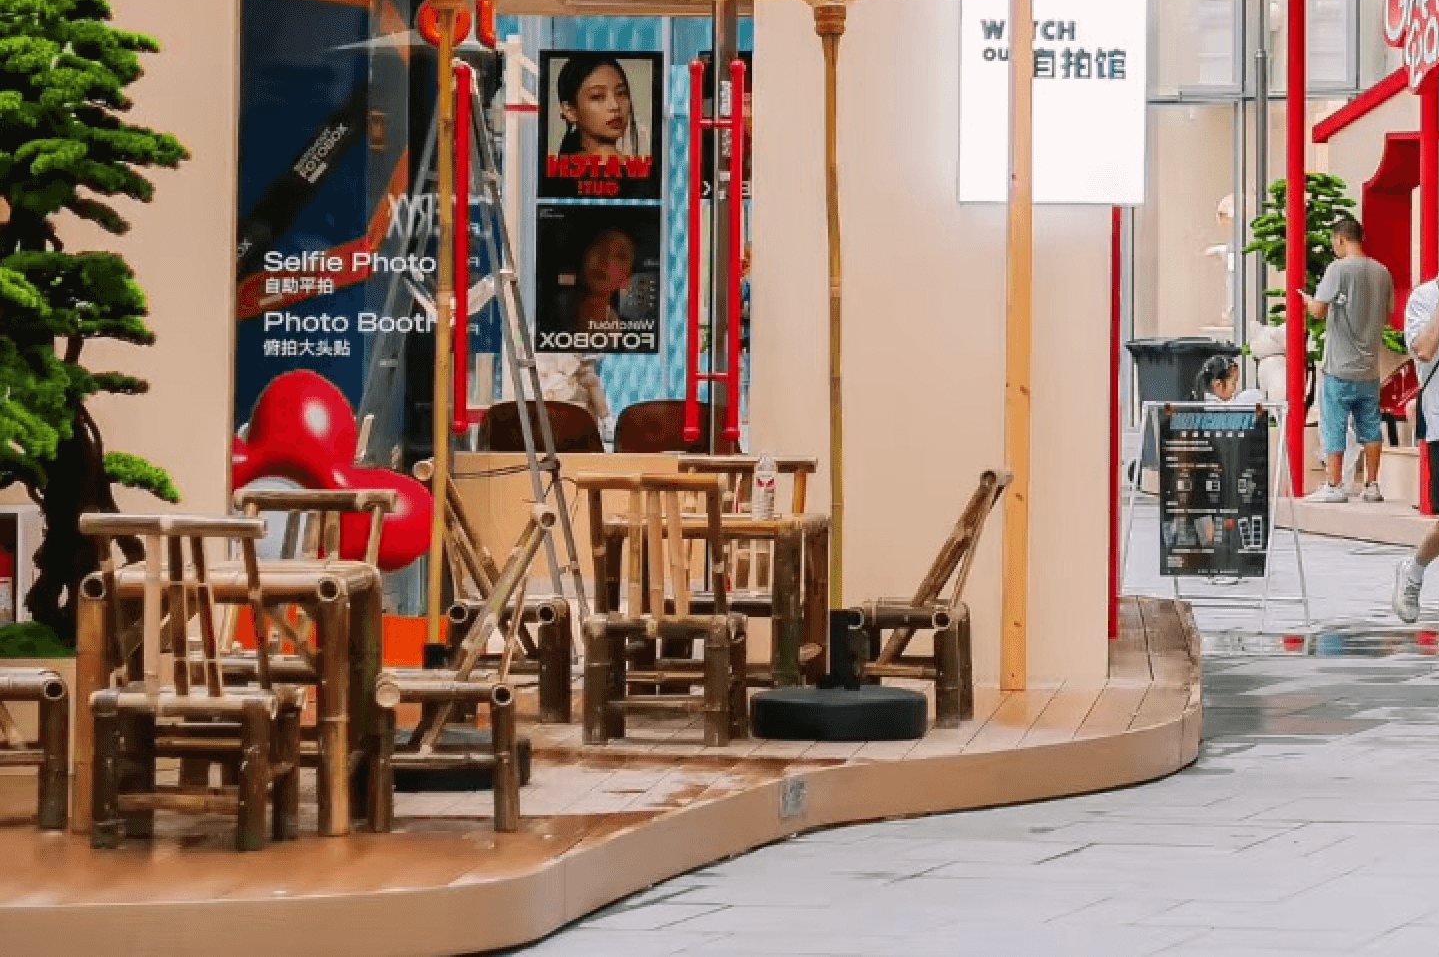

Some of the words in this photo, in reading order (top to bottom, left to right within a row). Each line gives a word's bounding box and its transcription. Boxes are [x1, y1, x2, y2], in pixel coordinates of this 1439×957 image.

[980, 19, 1076, 41] WCH
[982, 47, 1010, 62] OU
[1033, 47, 1126, 80] 自拍馆
[264, 250, 343, 272] Selfie
[351, 251, 437, 273] Photo
[264, 312, 349, 332] Photo
